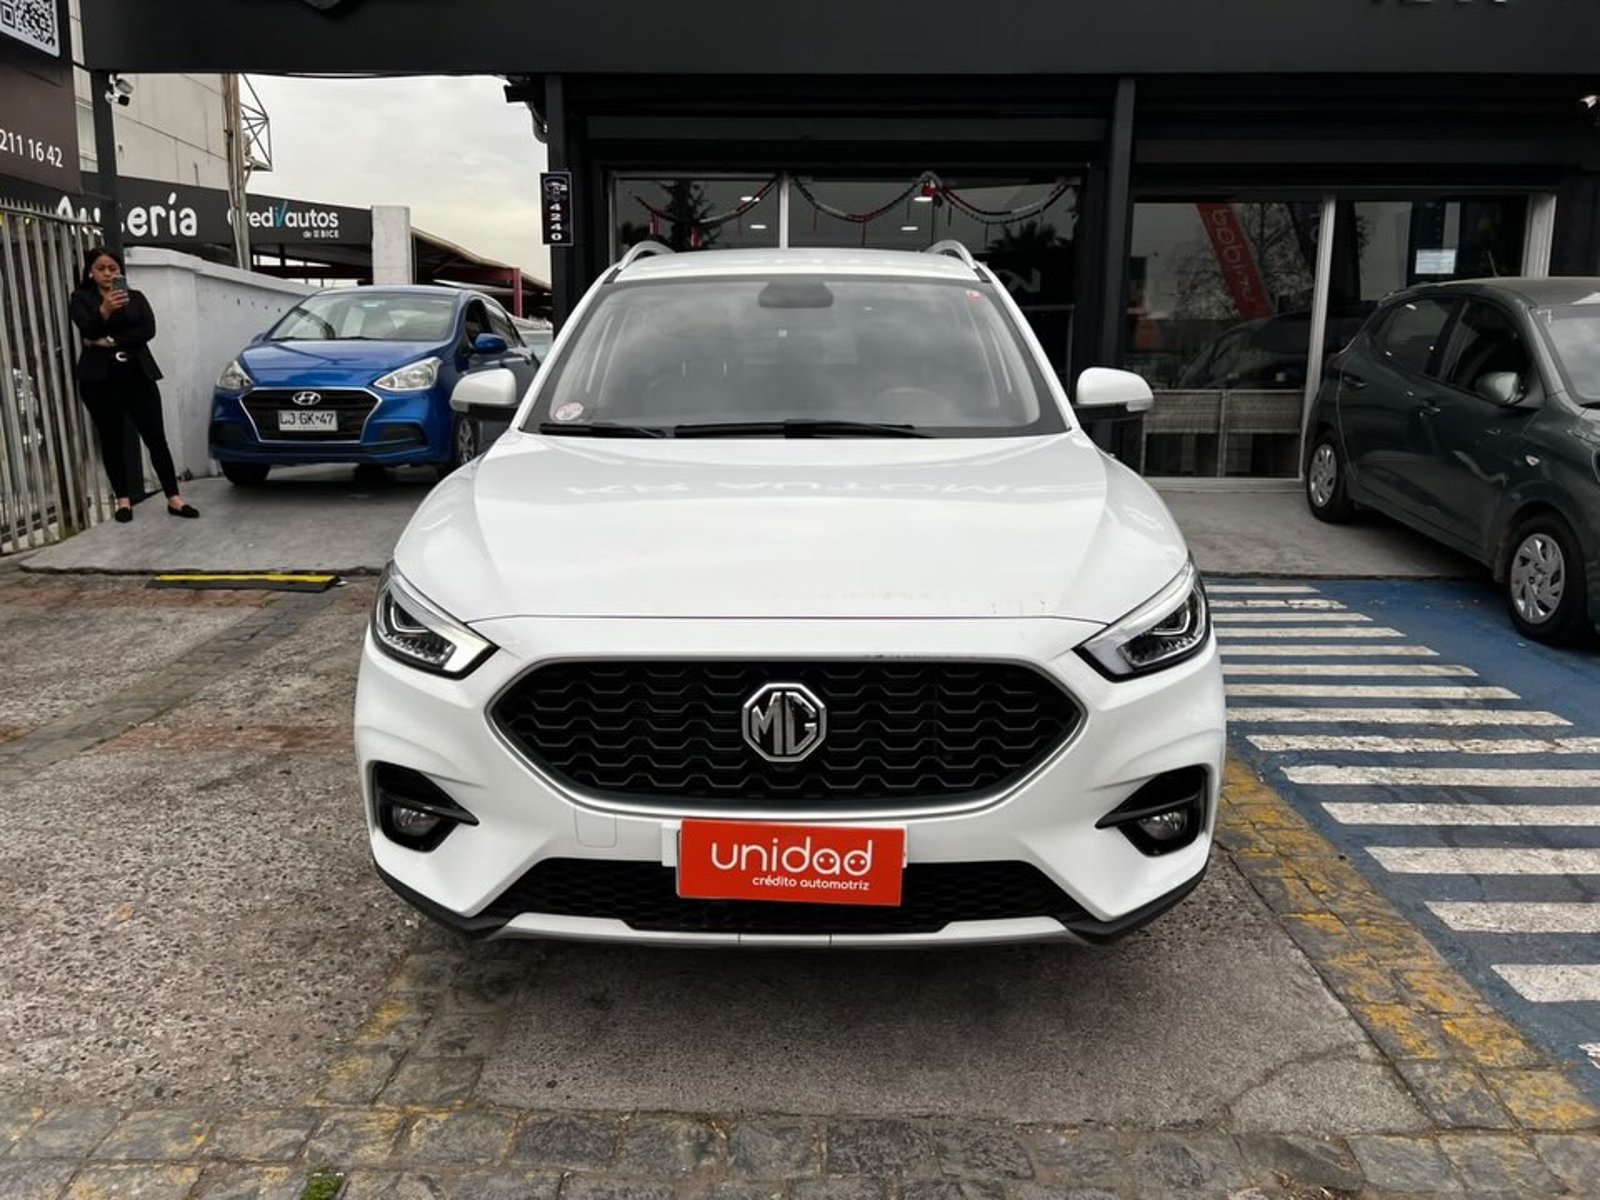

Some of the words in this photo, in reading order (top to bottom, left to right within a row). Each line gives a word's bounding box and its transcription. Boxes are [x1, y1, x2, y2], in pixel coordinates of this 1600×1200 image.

[750, 690, 818, 756] MG
[711, 836, 873, 877] unidad
[752, 874, 797, 888] crédito
[799, 877, 870, 891] automotriz
